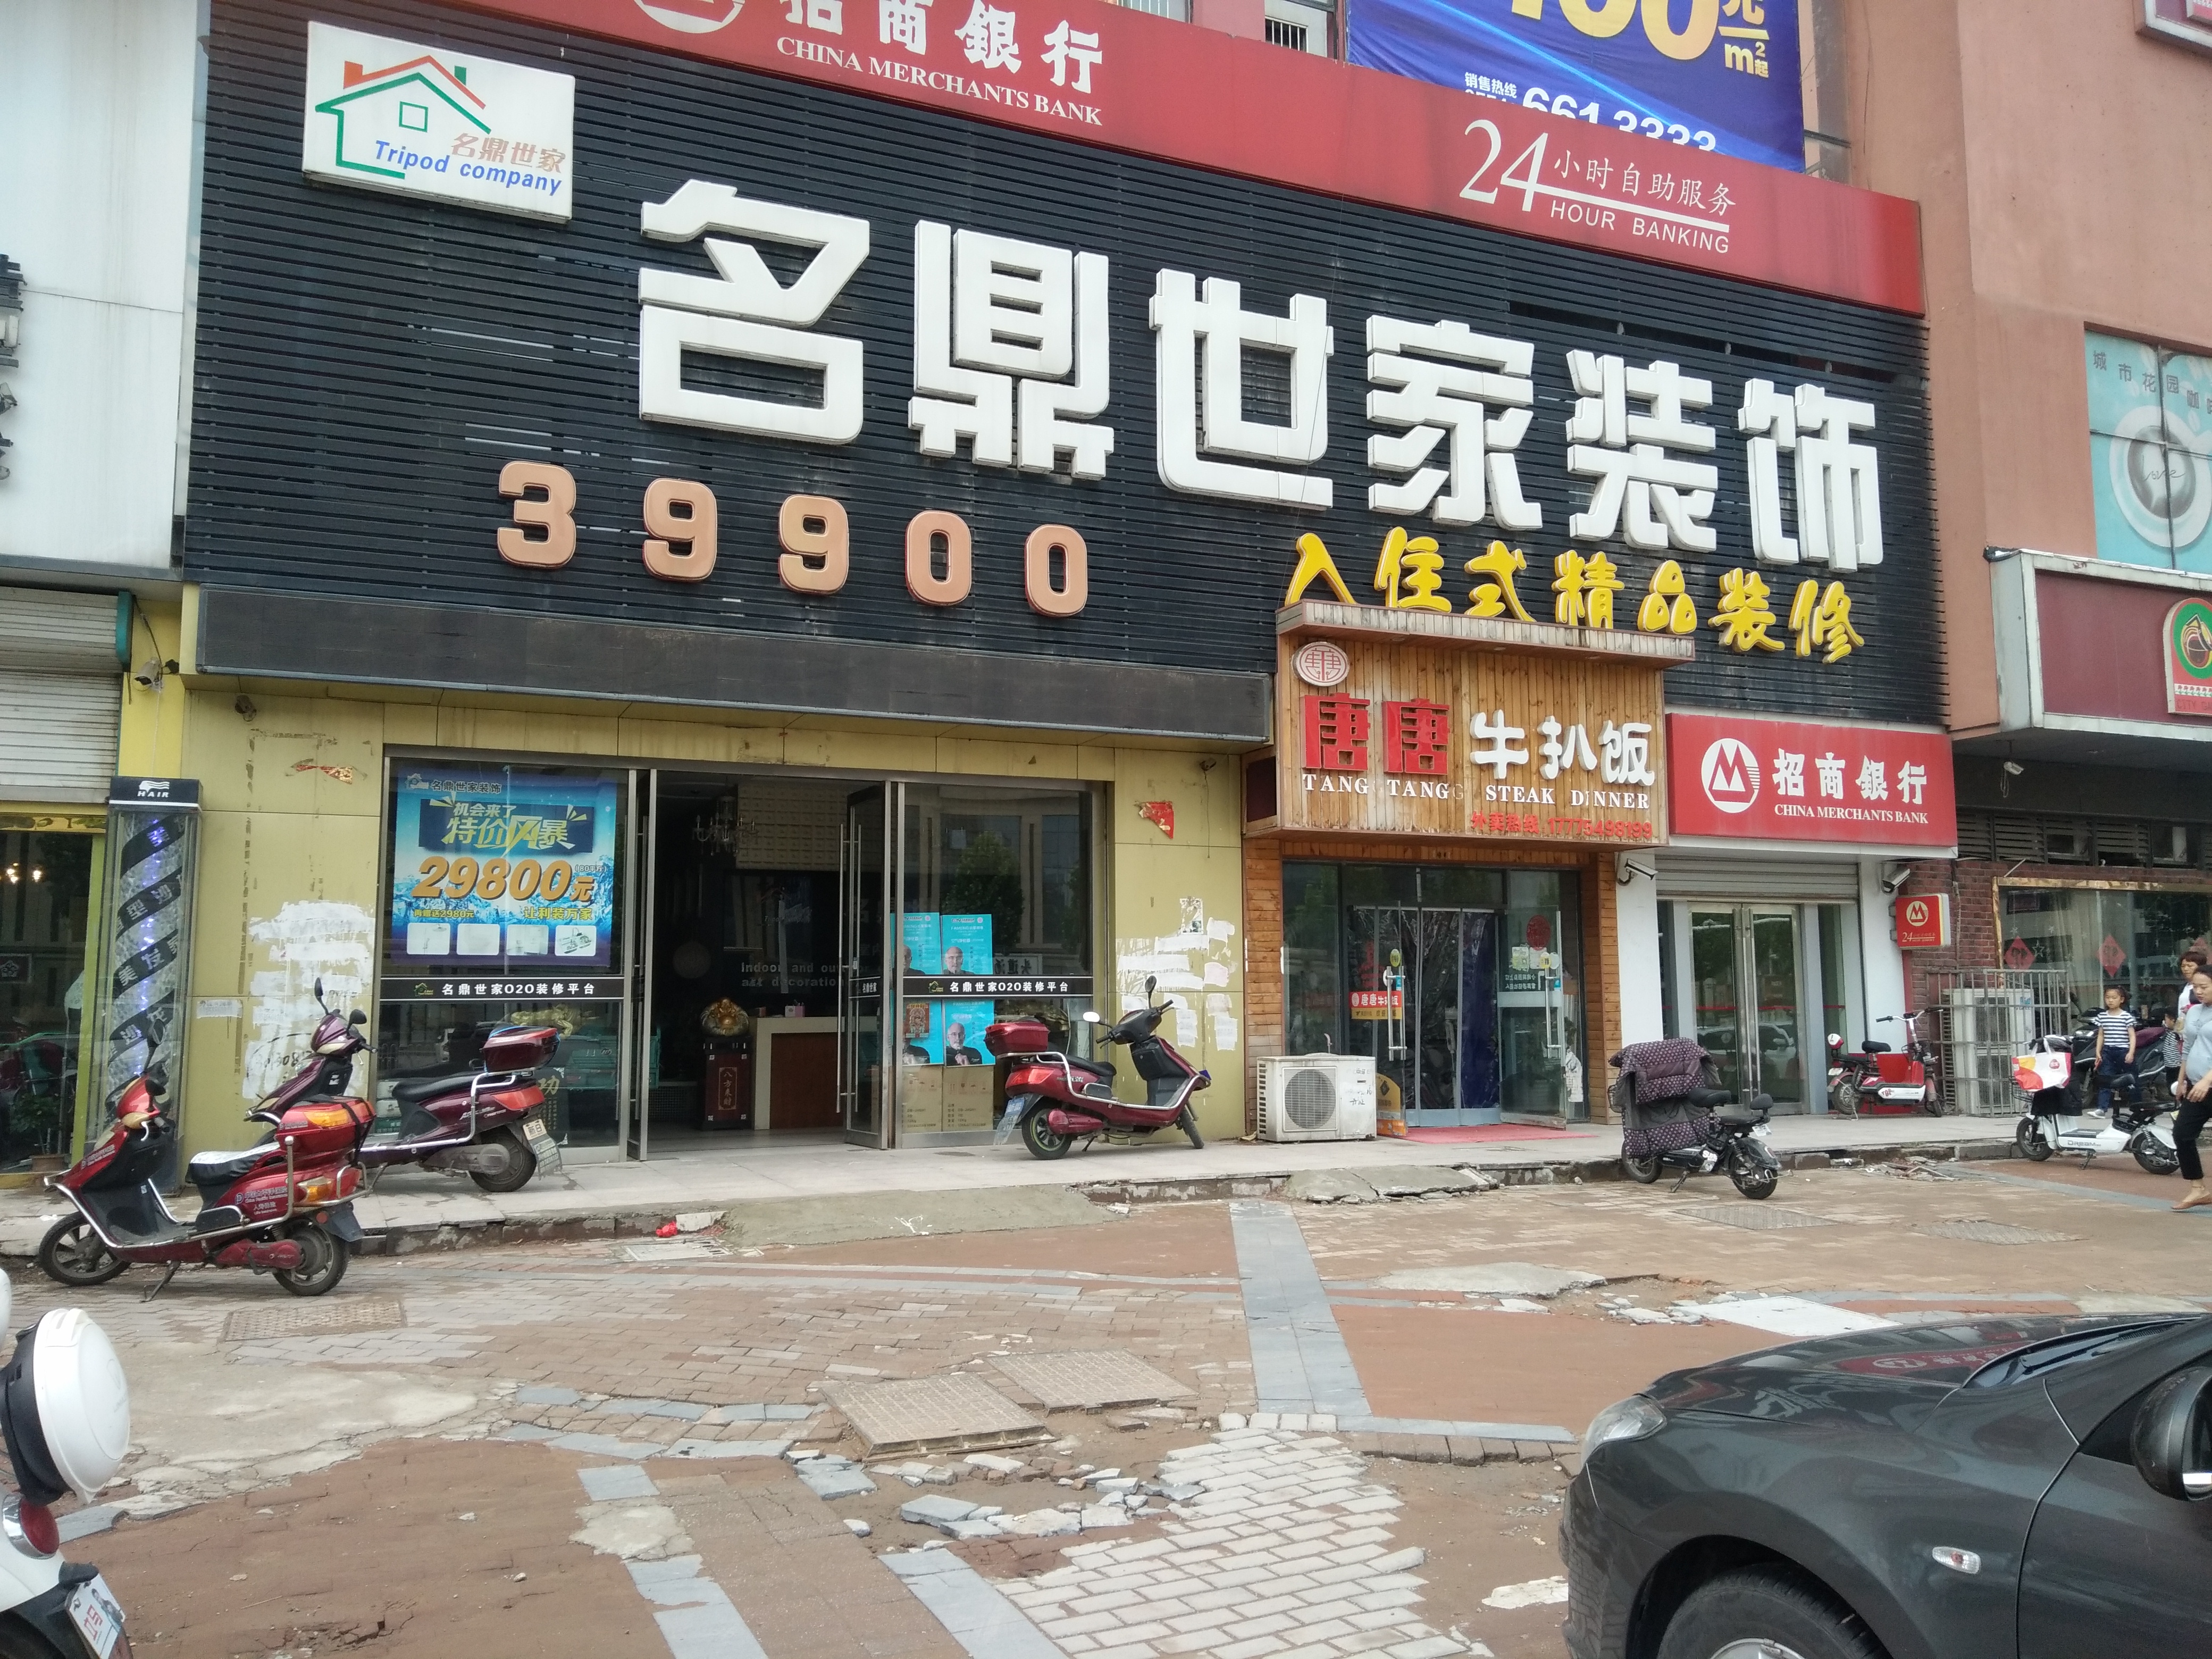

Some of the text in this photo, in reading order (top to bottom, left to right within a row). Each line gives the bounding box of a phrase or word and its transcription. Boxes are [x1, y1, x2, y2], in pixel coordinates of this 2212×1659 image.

[777, 36, 1103, 126] CHINA MERCHANTS BANK
[1464, 71, 1518, 99] 销售热线
[375, 140, 562, 196] Tripod company
[451, 132, 566, 174] 名鼎世家
[1459, 119, 1548, 212] 24
[1554, 149, 1737, 216] 小时自助服务
[1551, 199, 1730, 255] HOUR BANKING
[639, 179, 1884, 573] 名鼎世家装饰
[497, 460, 1089, 618] 39900
[1285, 525, 1865, 664] 入住式精品装修
[1469, 709, 1655, 787] 牛扒饭
[431, 780, 502, 794] 名鼎世家装饰
[1303, 774, 1369, 794] TANG
[1387, 779, 1449, 799] TANG
[1486, 785, 1555, 804] STEAK
[453, 802, 517, 817] 机会来了
[1471, 809, 1653, 839] 外卖热线 17775498199
[1774, 804, 1928, 824] CHINA MERCHANTS BANK
[441, 815, 575, 851] 特价风暴
[524, 907, 593, 920] 让利装万家
[741, 961, 780, 973] indoo
[791, 962, 814, 973] and
